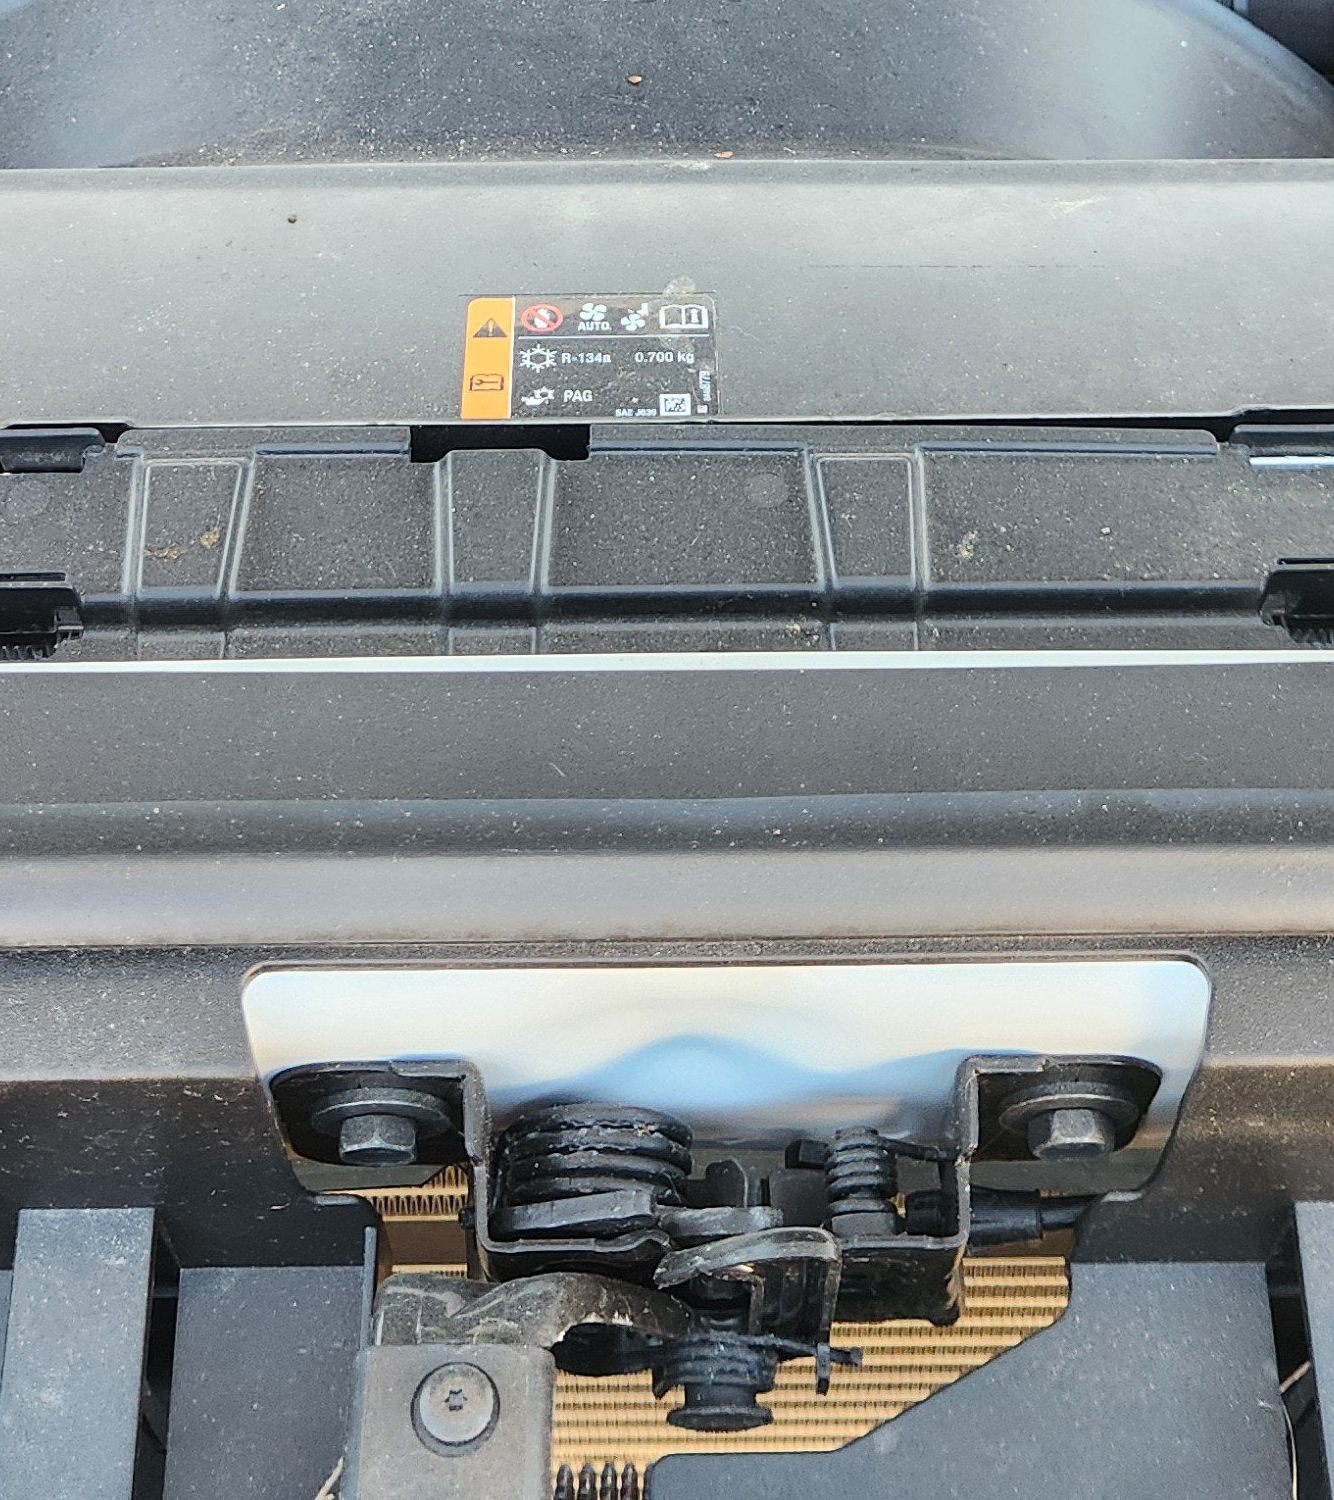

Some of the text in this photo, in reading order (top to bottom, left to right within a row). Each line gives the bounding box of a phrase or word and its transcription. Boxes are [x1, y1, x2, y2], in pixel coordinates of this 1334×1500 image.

[561, 351, 695, 364] R-134a 0.700 kg
[563, 389, 593, 402] PAG
[615, 408, 634, 417] SAE
